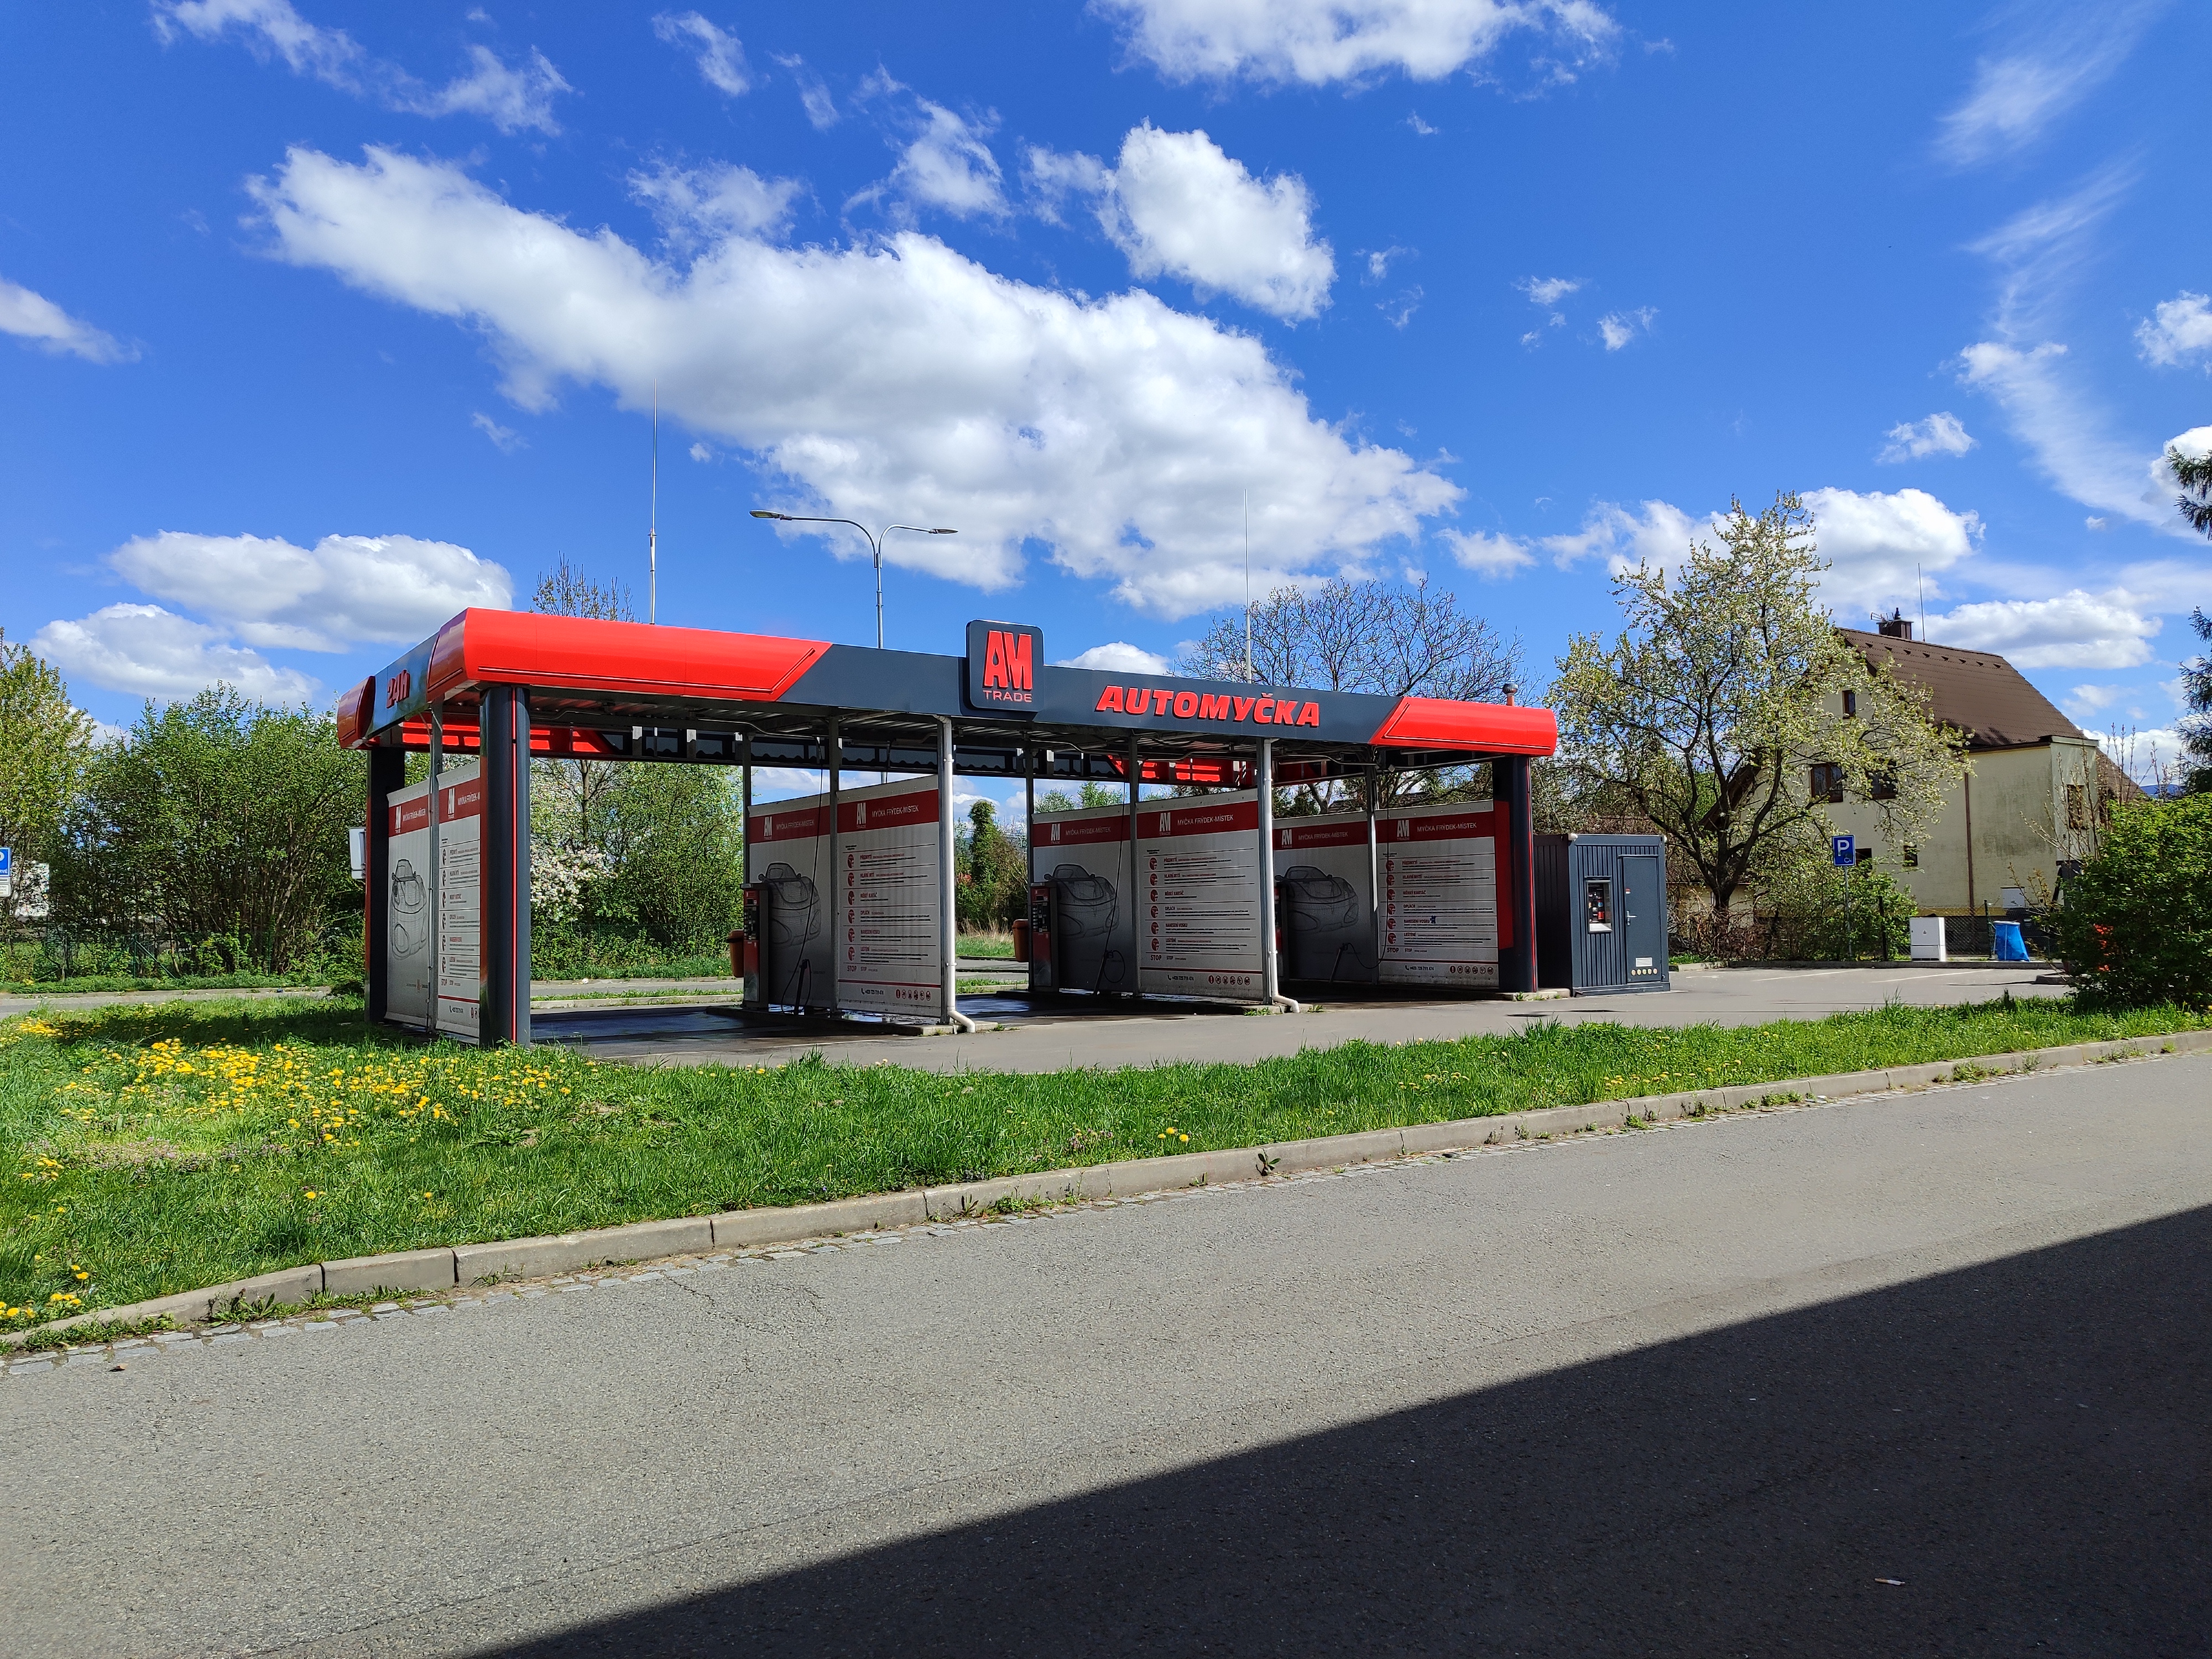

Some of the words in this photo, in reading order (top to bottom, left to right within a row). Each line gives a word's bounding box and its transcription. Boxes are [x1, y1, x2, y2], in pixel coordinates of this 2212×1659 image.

[983, 630, 1033, 691] AM
[387, 670, 410, 708] 24h
[983, 690, 1032, 702] TRADE
[1095, 685, 1319, 728] AUTOMYČKA
[448, 787, 455, 814] AM
[857, 802, 866, 825] AM
[872, 808, 886, 817] MYČKA
[886, 805, 919, 816] FRÝDEK-MÍSTEK
[1195, 814, 1233, 824] FRÝDEK-MÍSTEK
[764, 816, 772, 836] AM
[1160, 812, 1171, 832] AM
[1397, 820, 1409, 837] AM
[1436, 822, 1477, 831] FRÝDEK-MÍSTEK
[1051, 823, 1060, 841] AM
[1282, 830, 1292, 845] AM
[1838, 840, 1849, 856] P
